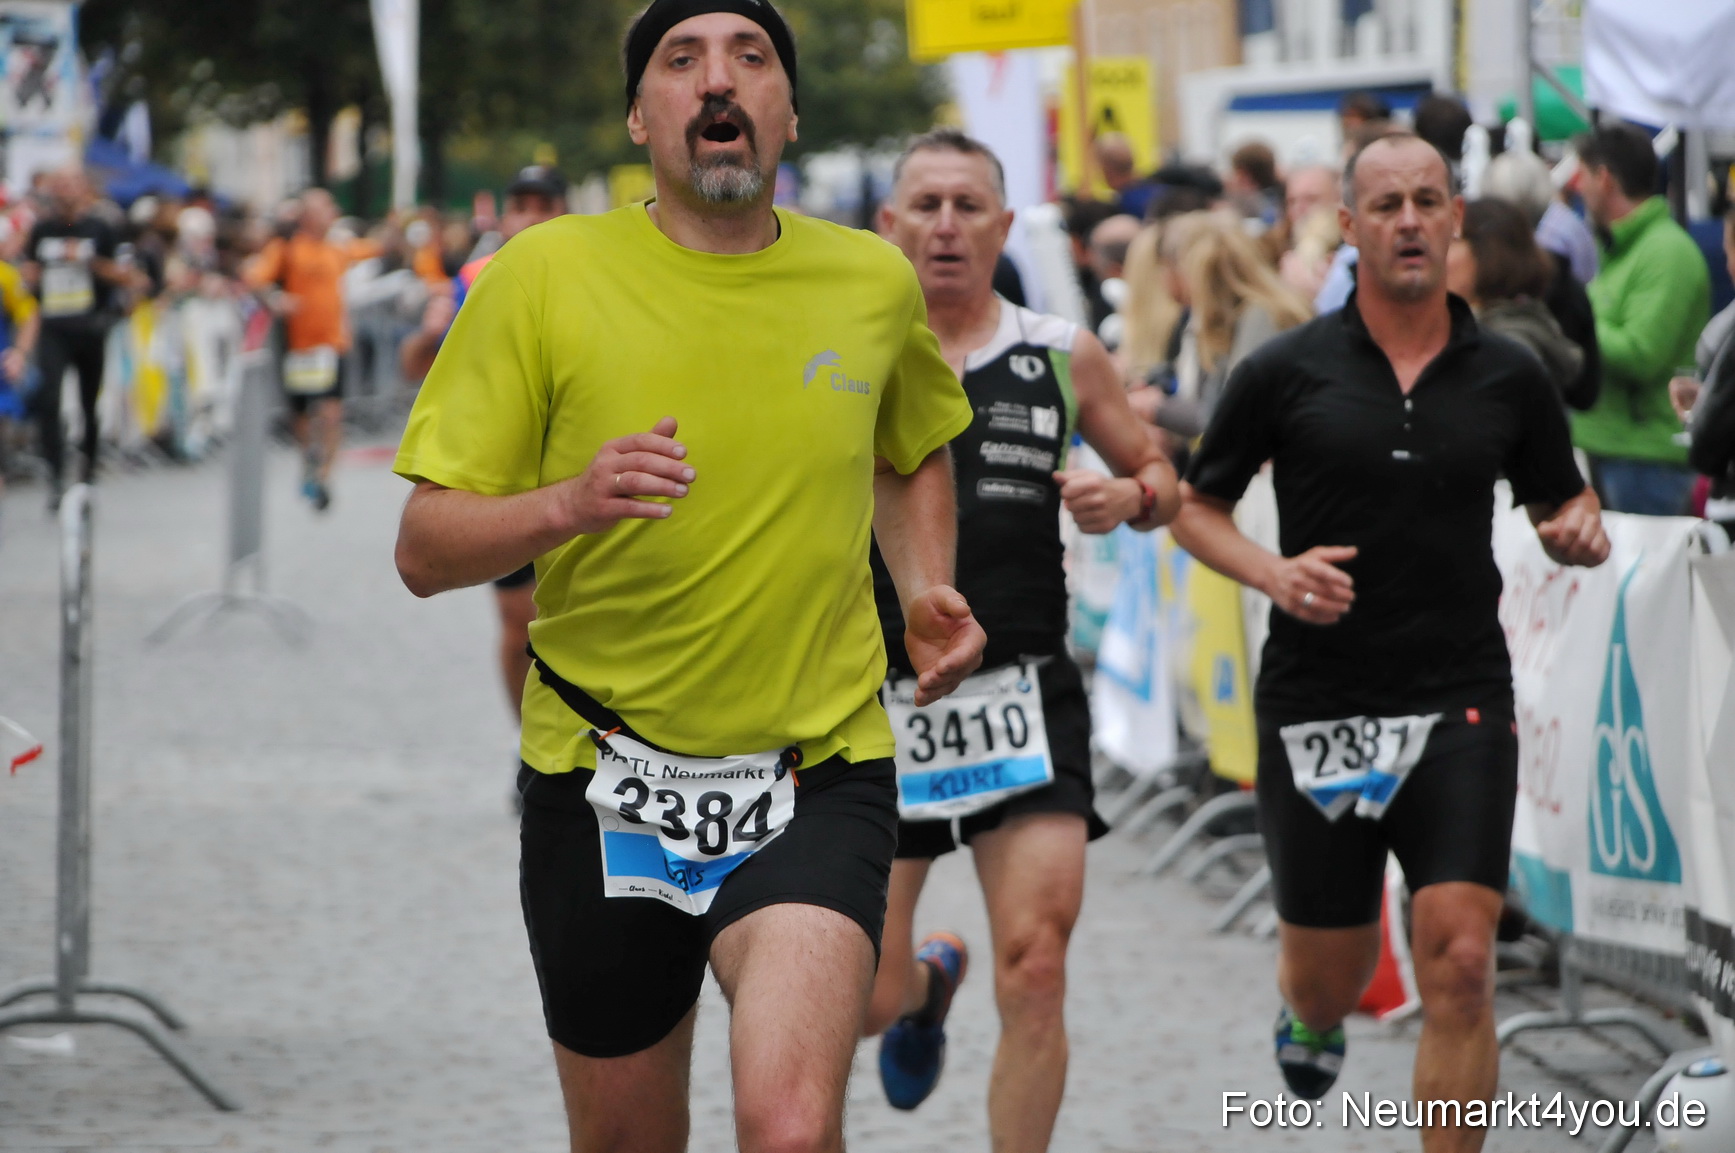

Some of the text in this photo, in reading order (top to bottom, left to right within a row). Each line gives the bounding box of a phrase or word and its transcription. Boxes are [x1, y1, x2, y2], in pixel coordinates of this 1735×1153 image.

[830, 372, 871, 395] Claus
[907, 702, 1029, 763] 3410
[661, 763, 766, 781] Neumarkt
[928, 762, 1006, 802] KURT
[612, 776, 775, 856] 3384
